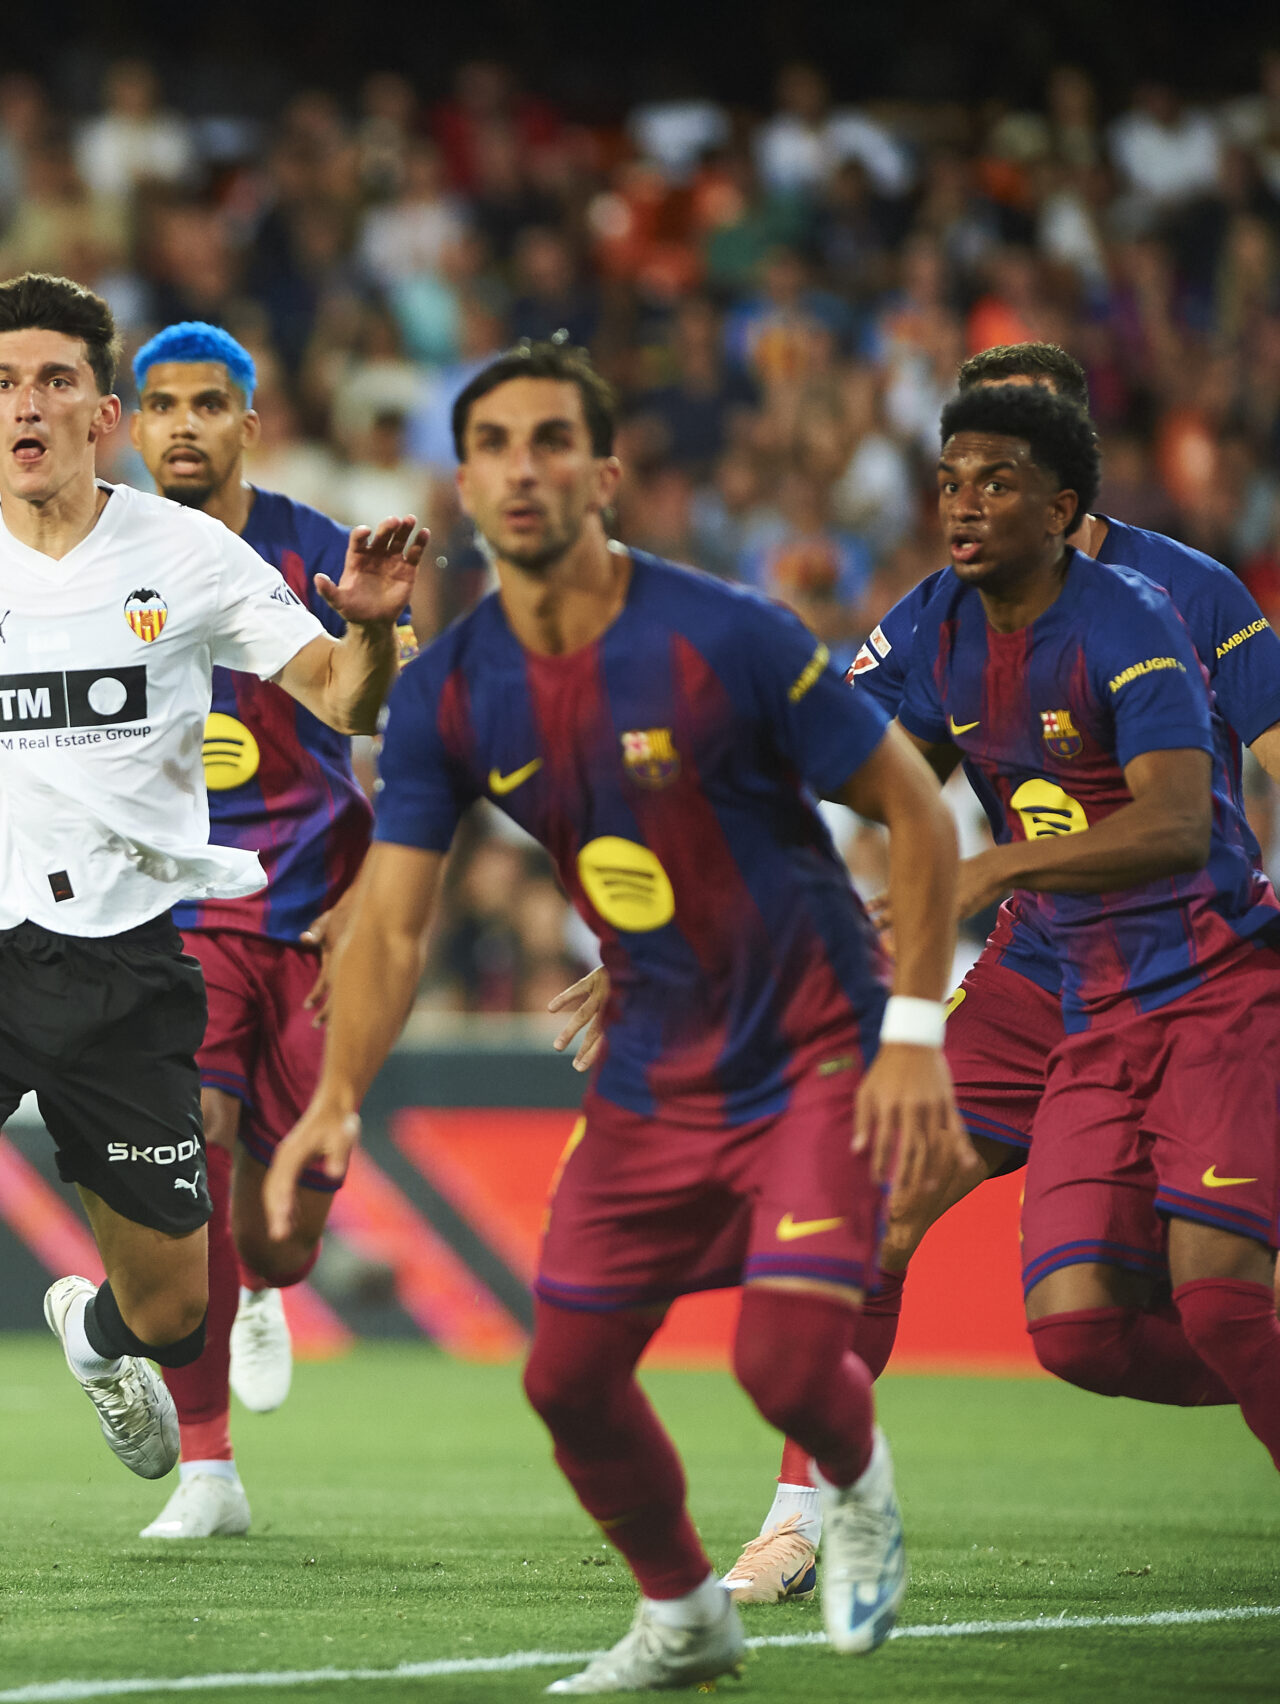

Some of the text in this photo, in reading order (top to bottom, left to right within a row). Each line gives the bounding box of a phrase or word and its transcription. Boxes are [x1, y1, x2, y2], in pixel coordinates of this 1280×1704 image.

[1215, 617, 1270, 659] AMBILIGH
[1108, 657, 1177, 694] AMBILIGHT
[19, 735, 50, 750] Real
[55, 732, 102, 747] Estate
[105, 725, 152, 742] Group
